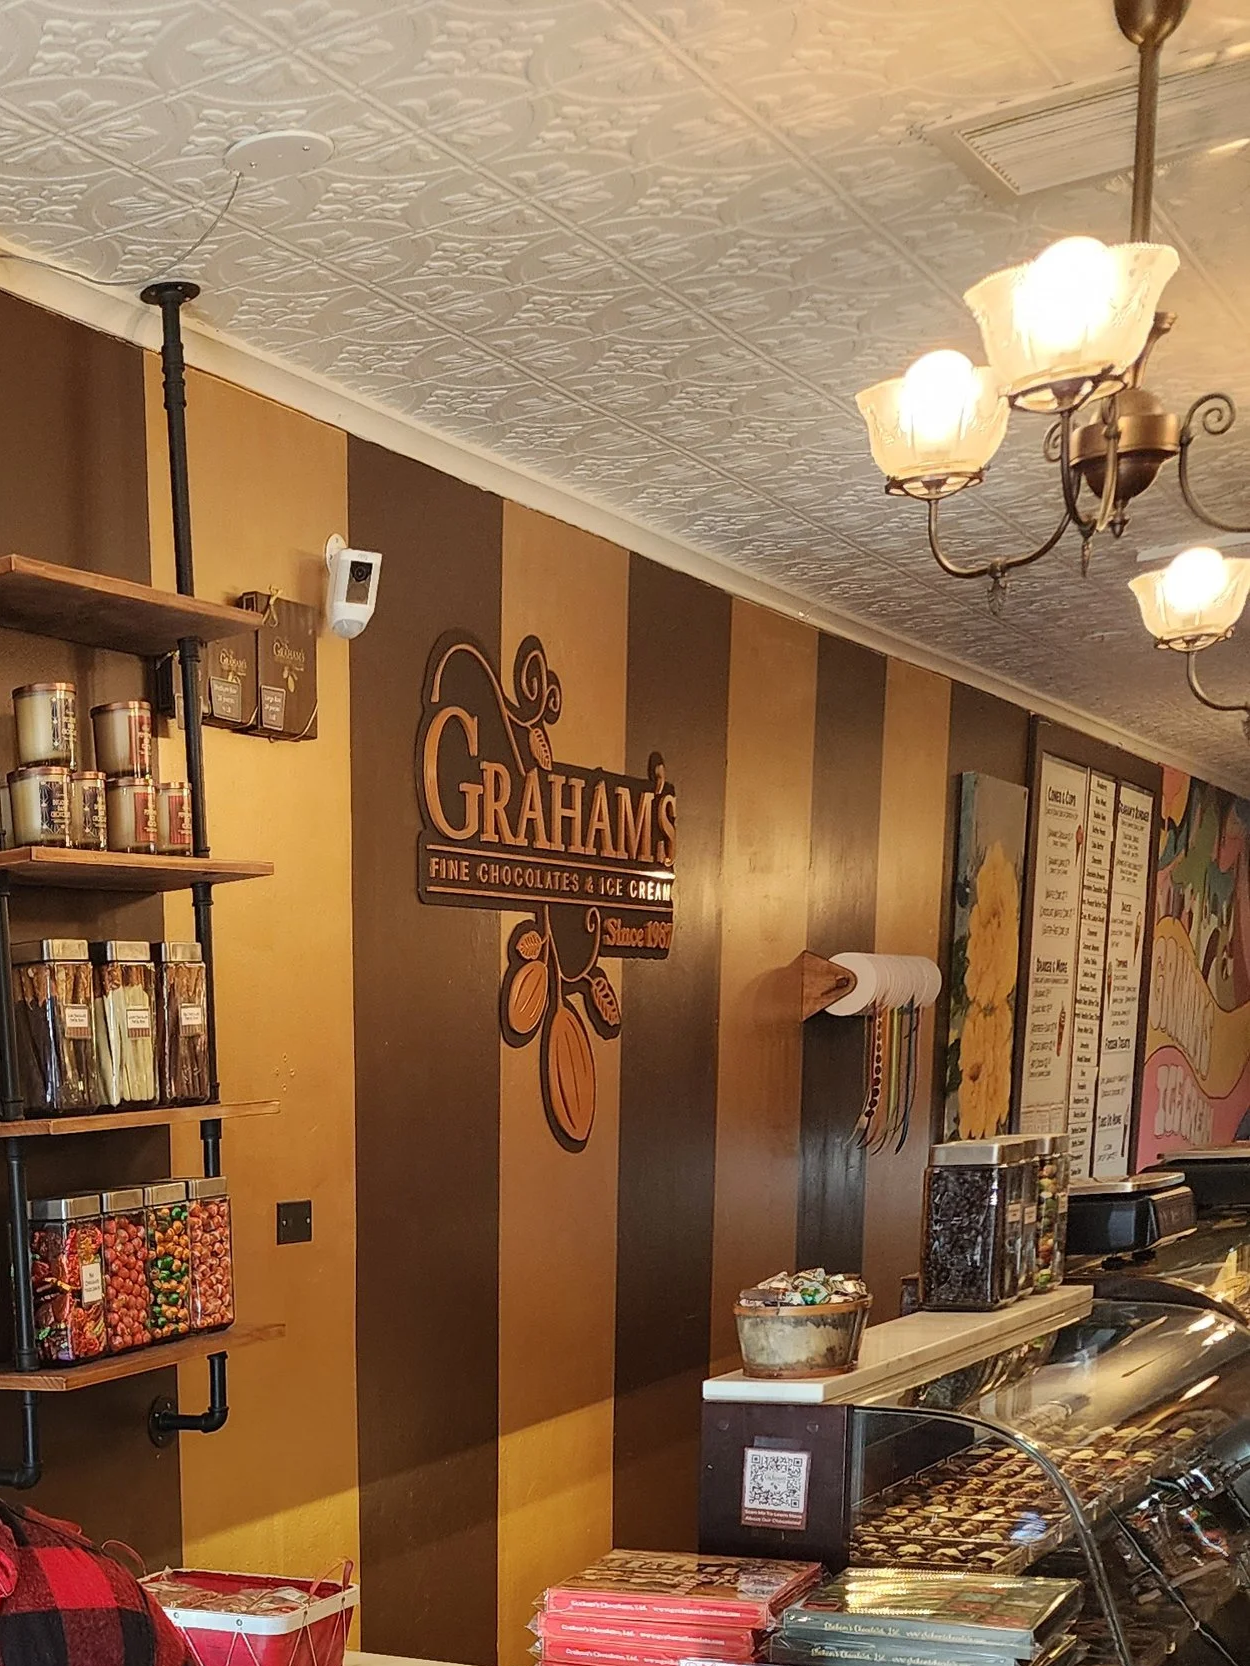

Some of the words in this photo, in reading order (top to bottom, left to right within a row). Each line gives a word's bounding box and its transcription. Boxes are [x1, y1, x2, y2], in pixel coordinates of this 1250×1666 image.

[424, 705, 676, 867] GRAHAM'S
[429, 857, 470, 882] FINE
[478, 863, 579, 892] CHOCOLATES
[585, 876, 594, 893] &
[600, 876, 623, 896] ICE
[630, 880, 671, 901] CREAM
[603, 917, 645, 946] Since
